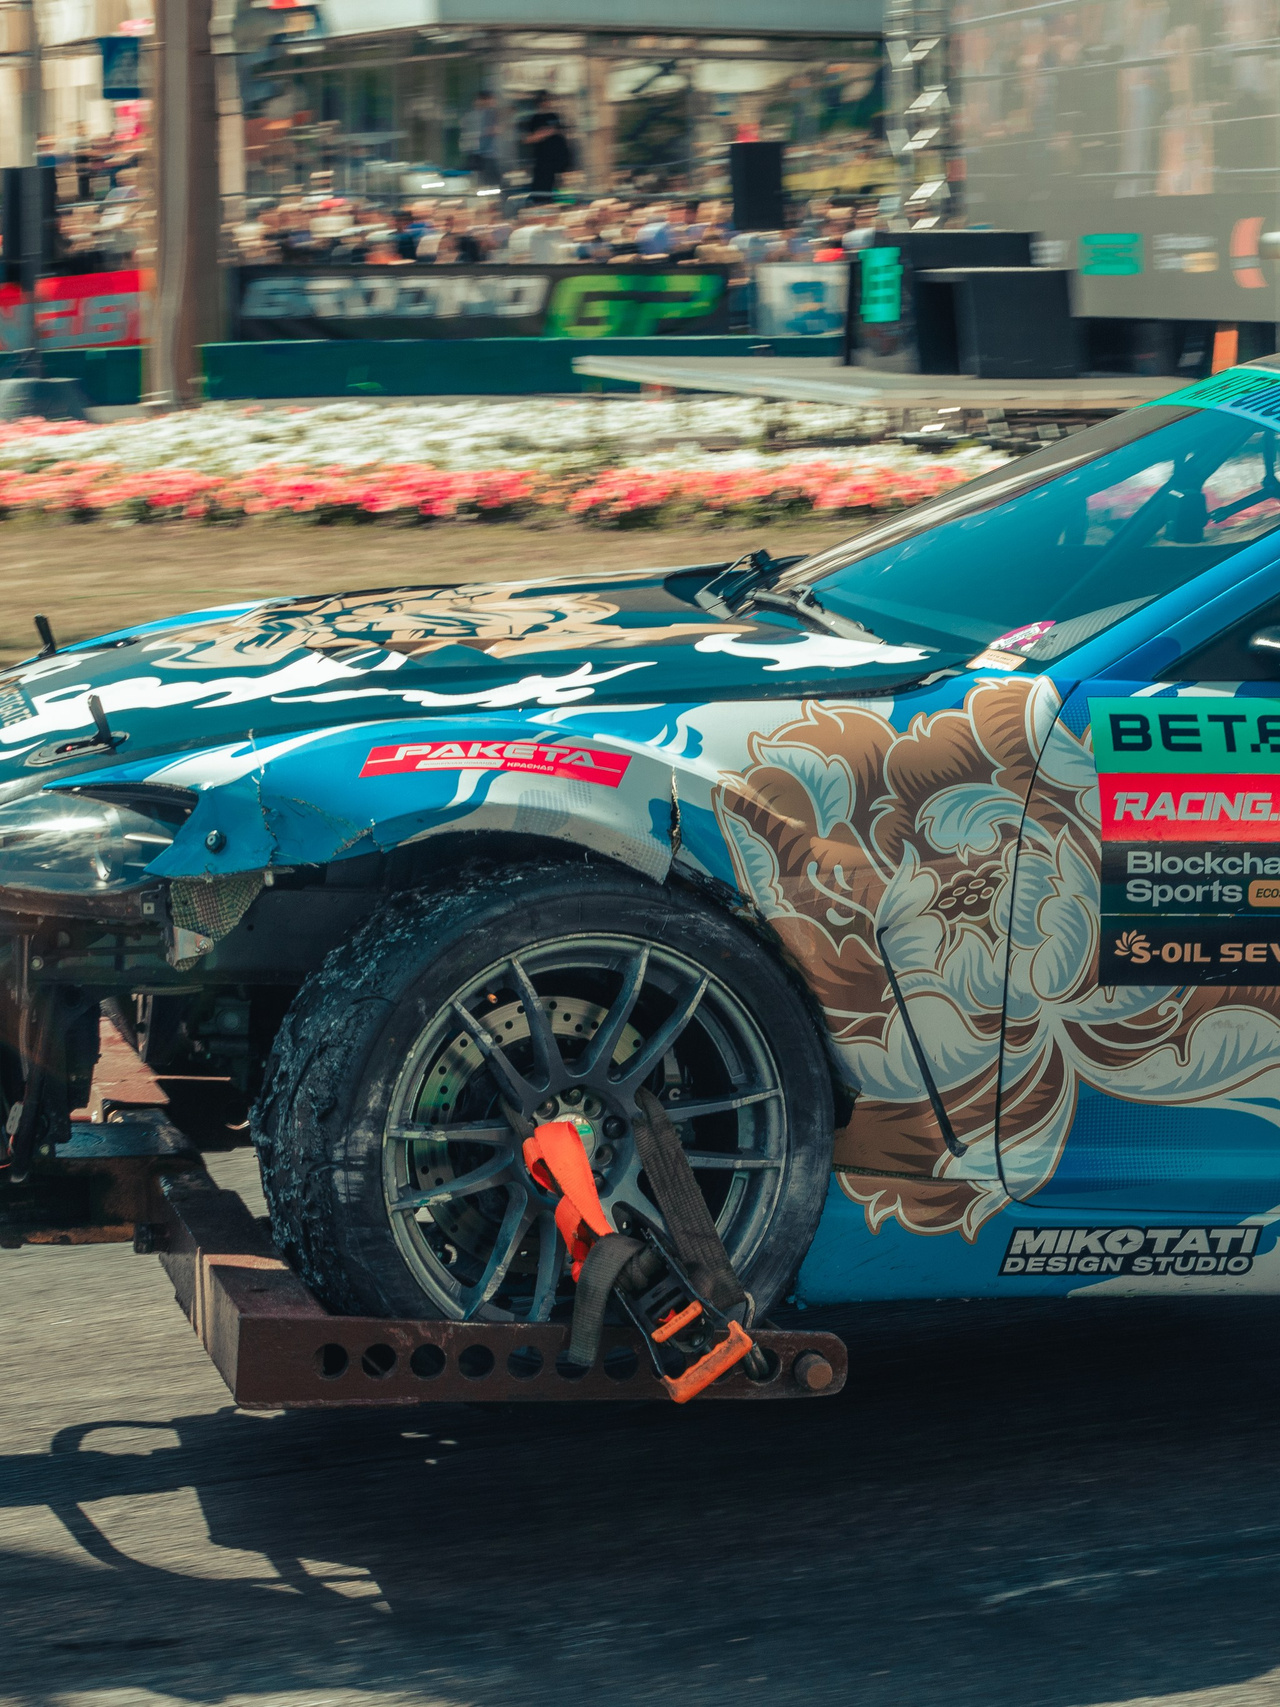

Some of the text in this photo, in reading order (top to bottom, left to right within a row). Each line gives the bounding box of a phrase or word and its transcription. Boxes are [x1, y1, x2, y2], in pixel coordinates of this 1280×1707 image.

[394, 743, 597, 768] РАКЕТА
[506, 761, 554, 772] КРАСНАЯ
[1125, 878, 1243, 907] Sports
[1130, 940, 1211, 964] S-OIL
[1009, 1228, 1259, 1255] MIKOTATI
[1003, 1255, 1254, 1274] DESIGN STUDIO
